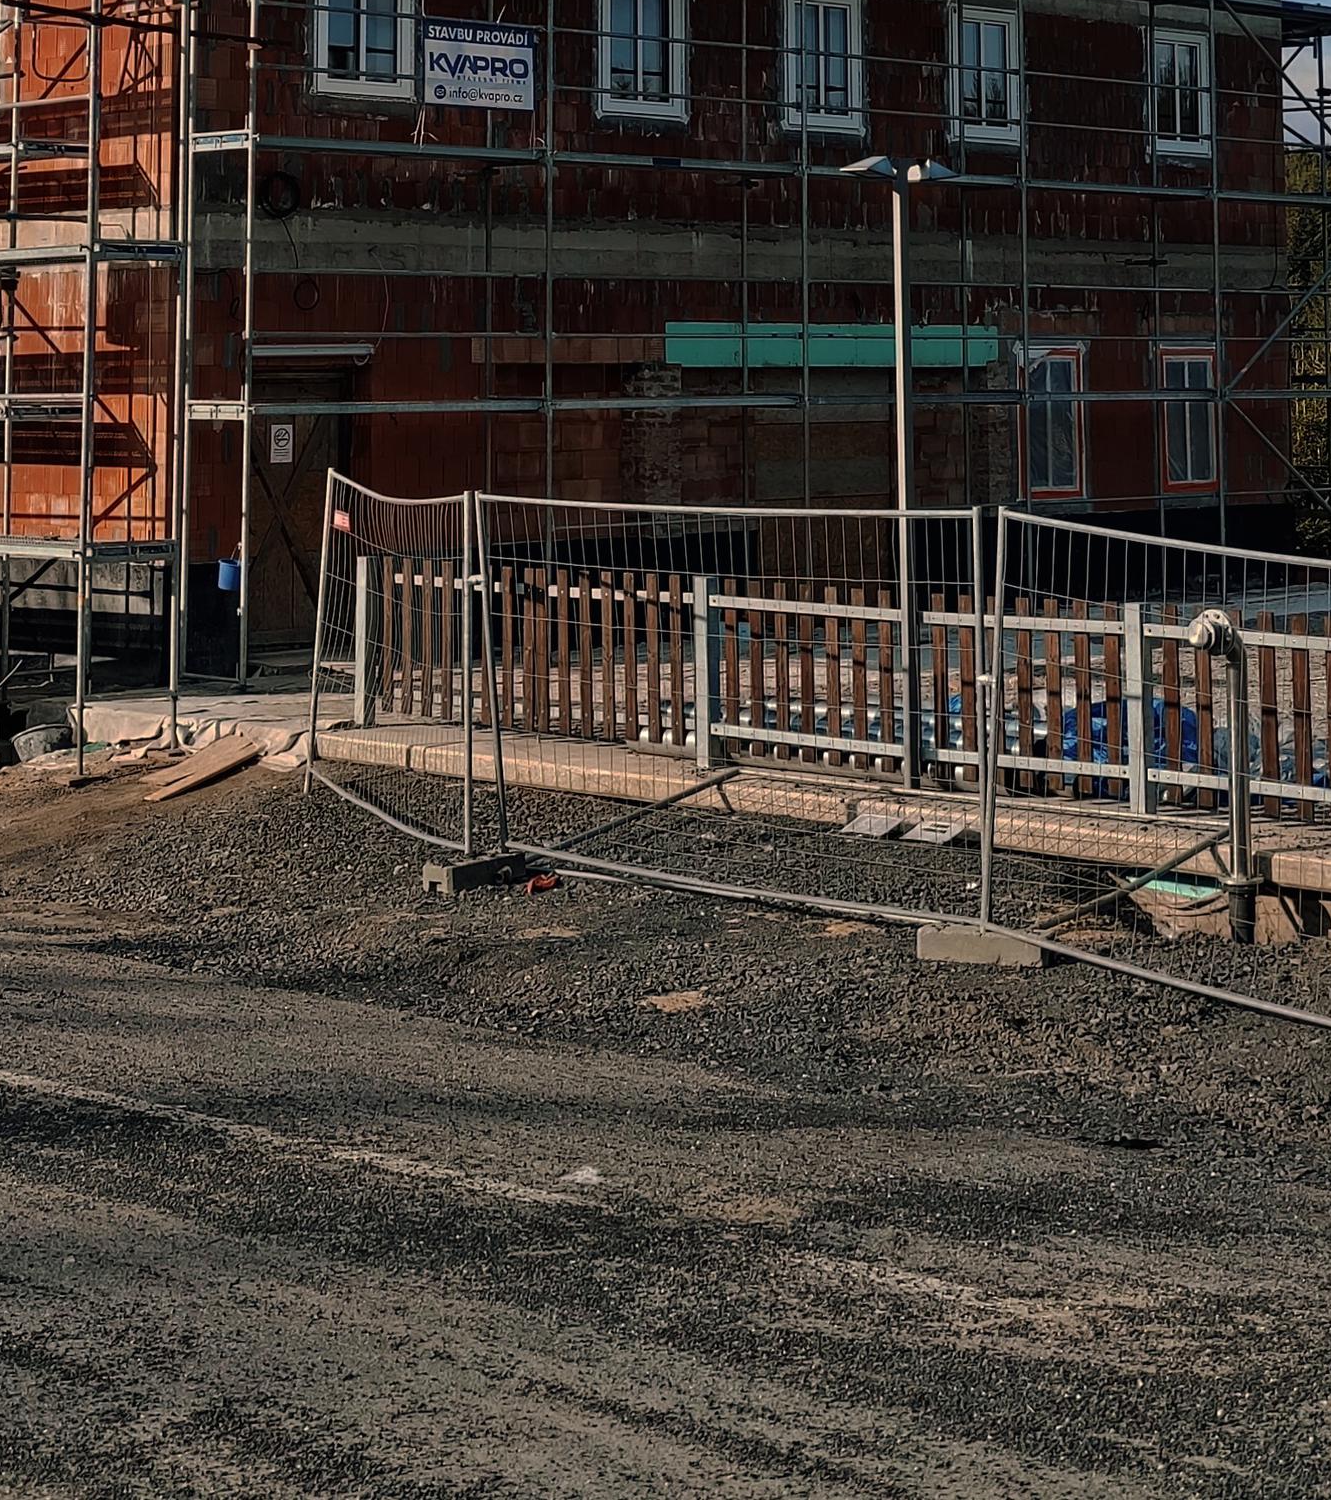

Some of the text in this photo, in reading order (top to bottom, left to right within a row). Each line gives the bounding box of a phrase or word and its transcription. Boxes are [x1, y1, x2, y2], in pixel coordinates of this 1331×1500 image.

[428, 25, 528, 46] STAVBU PROVÁDÍ
[429, 51, 529, 79] KVAPRO
[449, 86, 524, 104] info@kvapro.cz
